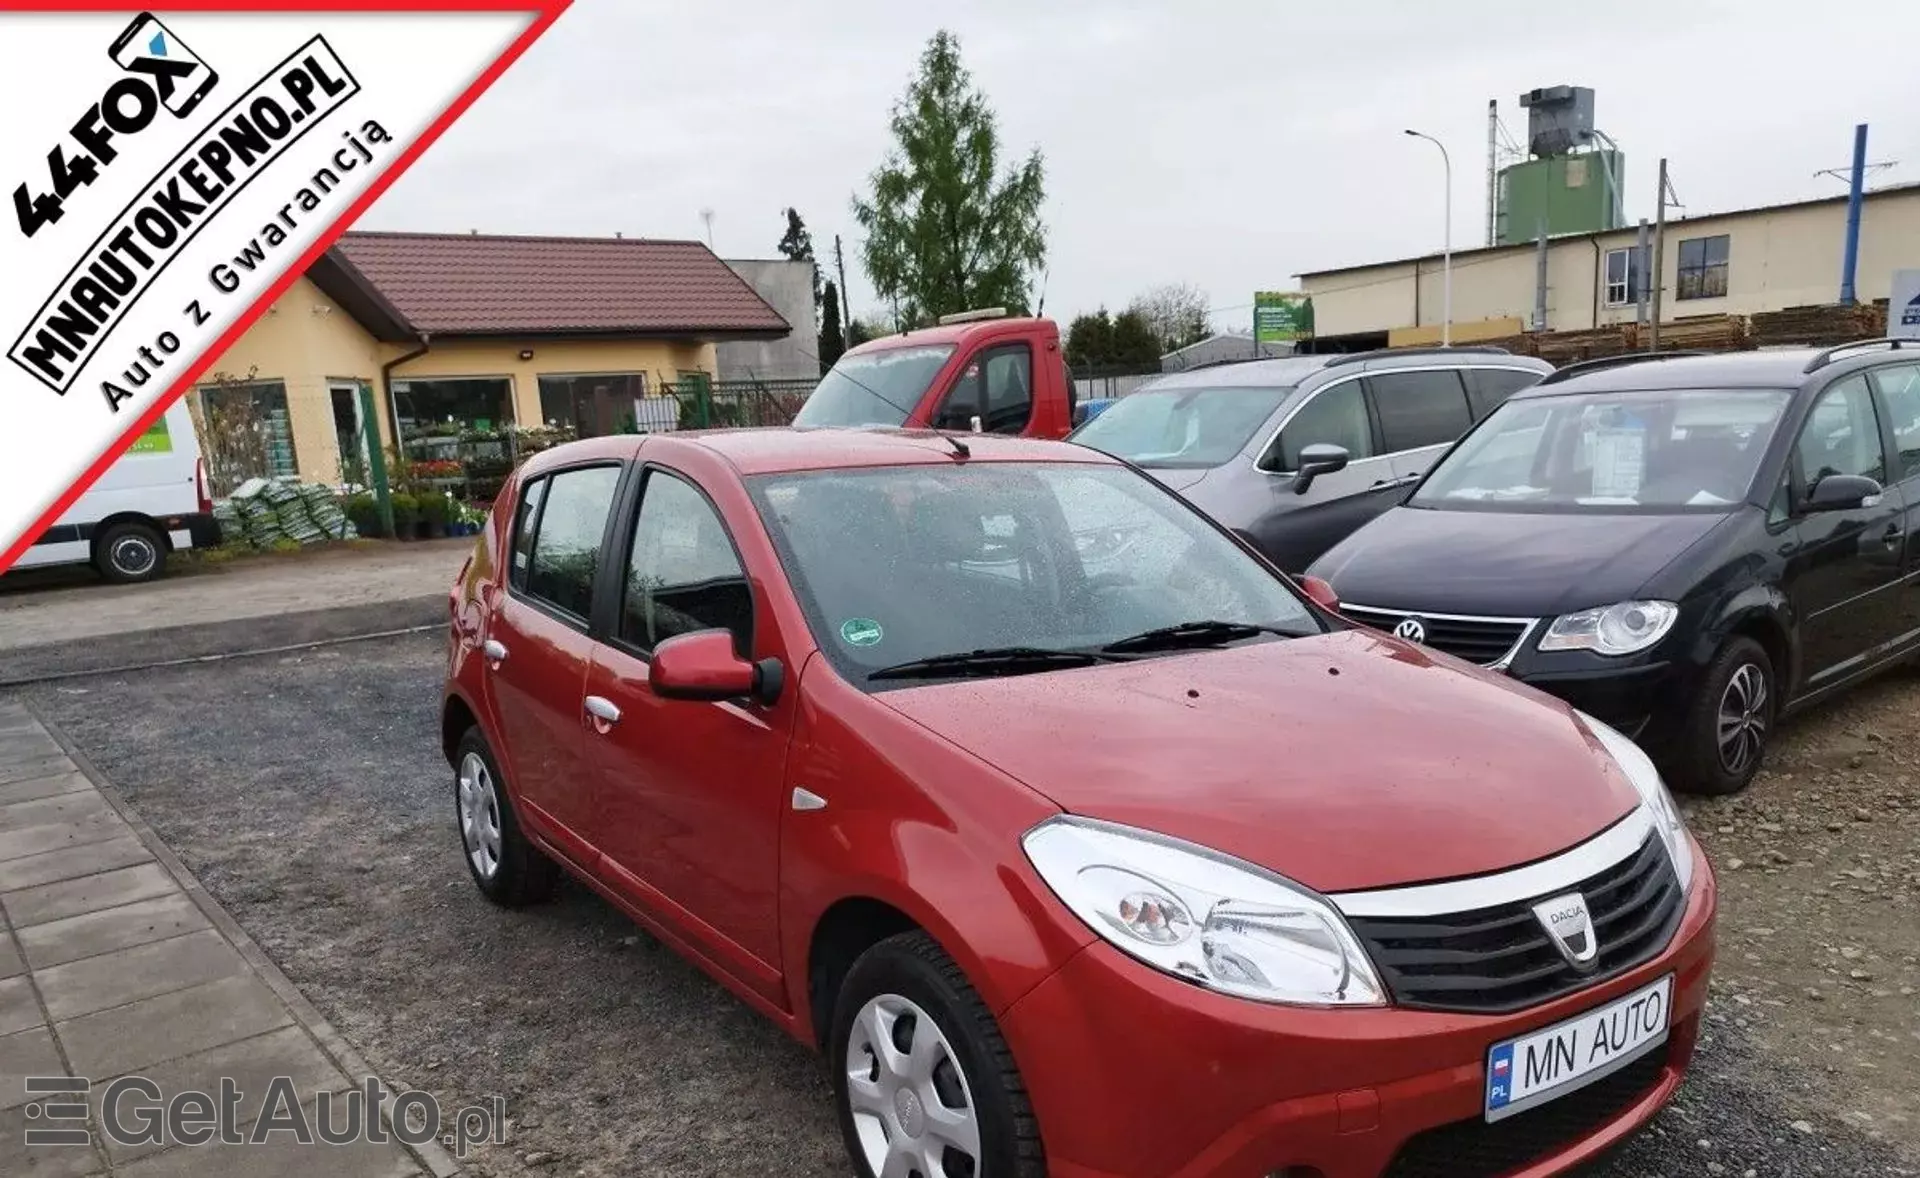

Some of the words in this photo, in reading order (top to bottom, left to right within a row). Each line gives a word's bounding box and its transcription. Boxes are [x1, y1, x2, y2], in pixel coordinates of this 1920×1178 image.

[1549, 905, 1585, 925] DACIA
[1524, 1029, 1577, 1089] MN
[1589, 990, 1662, 1064] AUTO
[1491, 1084, 1507, 1098] PL
